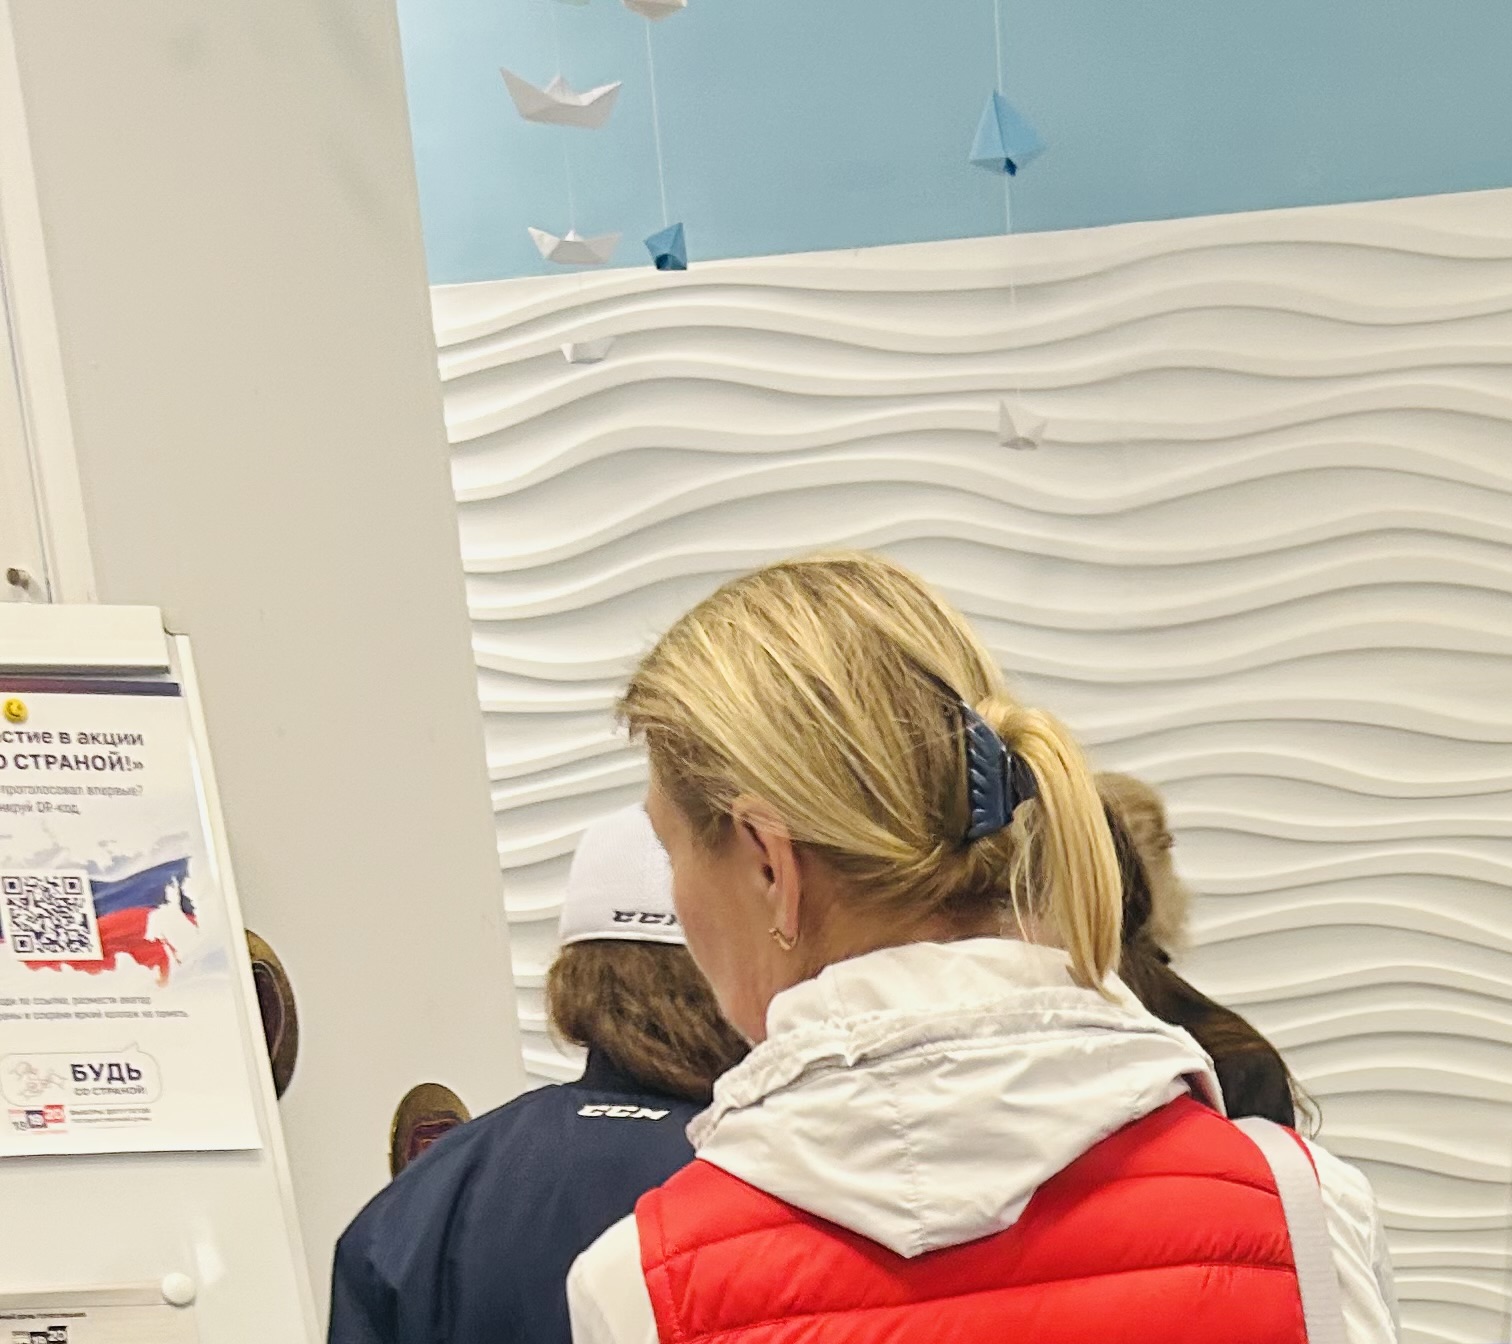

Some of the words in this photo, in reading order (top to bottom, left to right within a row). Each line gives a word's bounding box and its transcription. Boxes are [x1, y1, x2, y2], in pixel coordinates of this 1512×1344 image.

[0, 731, 53, 744] стие
[59, 731, 71, 744] в
[77, 732, 144, 747] акции
[70, 1063, 142, 1084] БУДЬ
